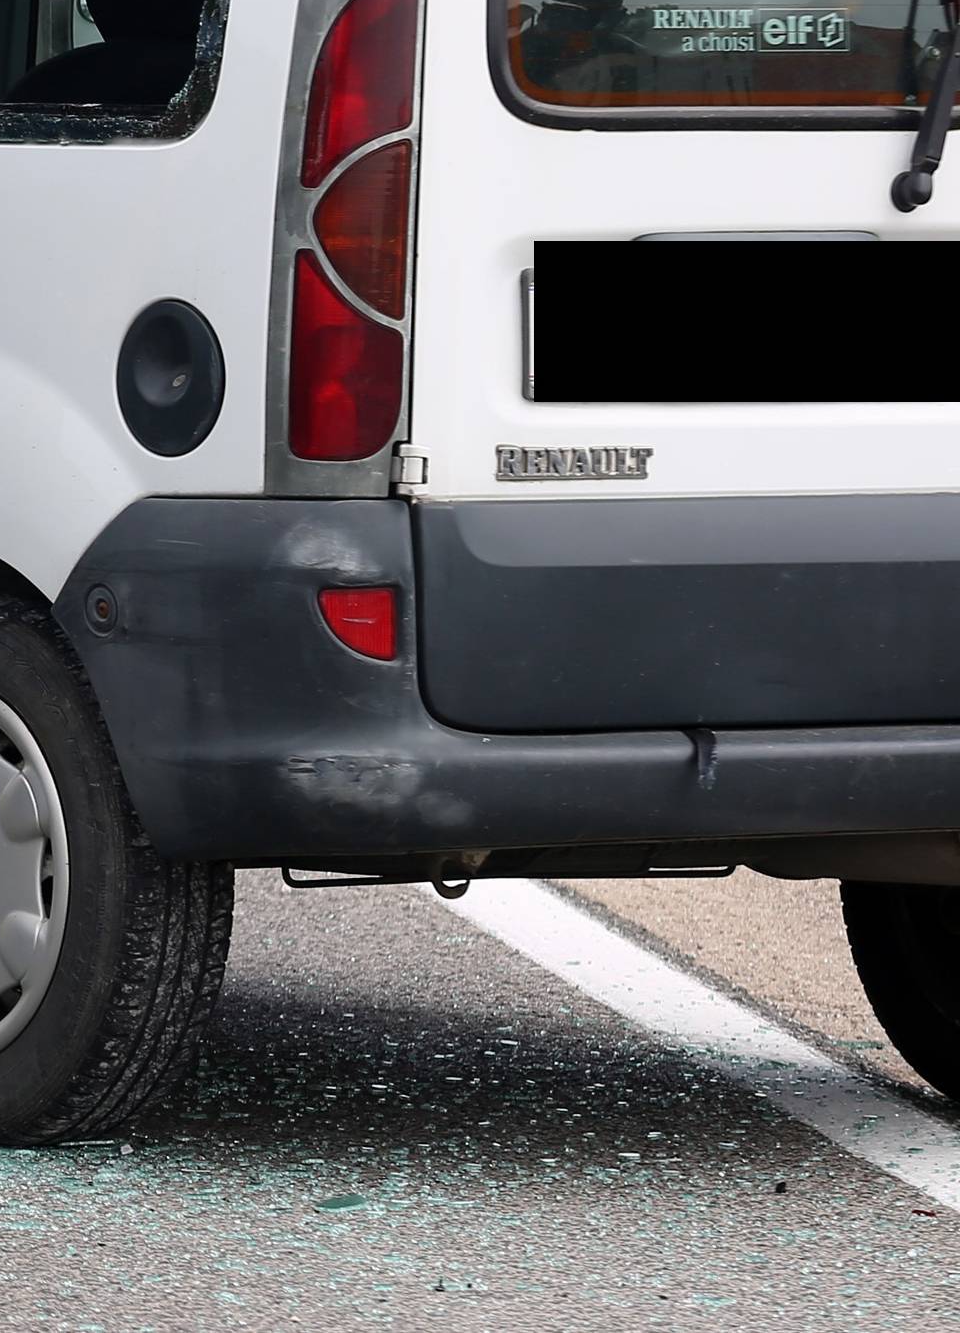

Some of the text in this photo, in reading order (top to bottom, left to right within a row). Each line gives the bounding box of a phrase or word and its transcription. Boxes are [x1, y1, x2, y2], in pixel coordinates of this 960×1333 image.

[653, 10, 753, 29] RENAULT
[763, 16, 813, 45] elf
[682, 32, 755, 52] a choisi
[496, 445, 654, 481] RENAULT
